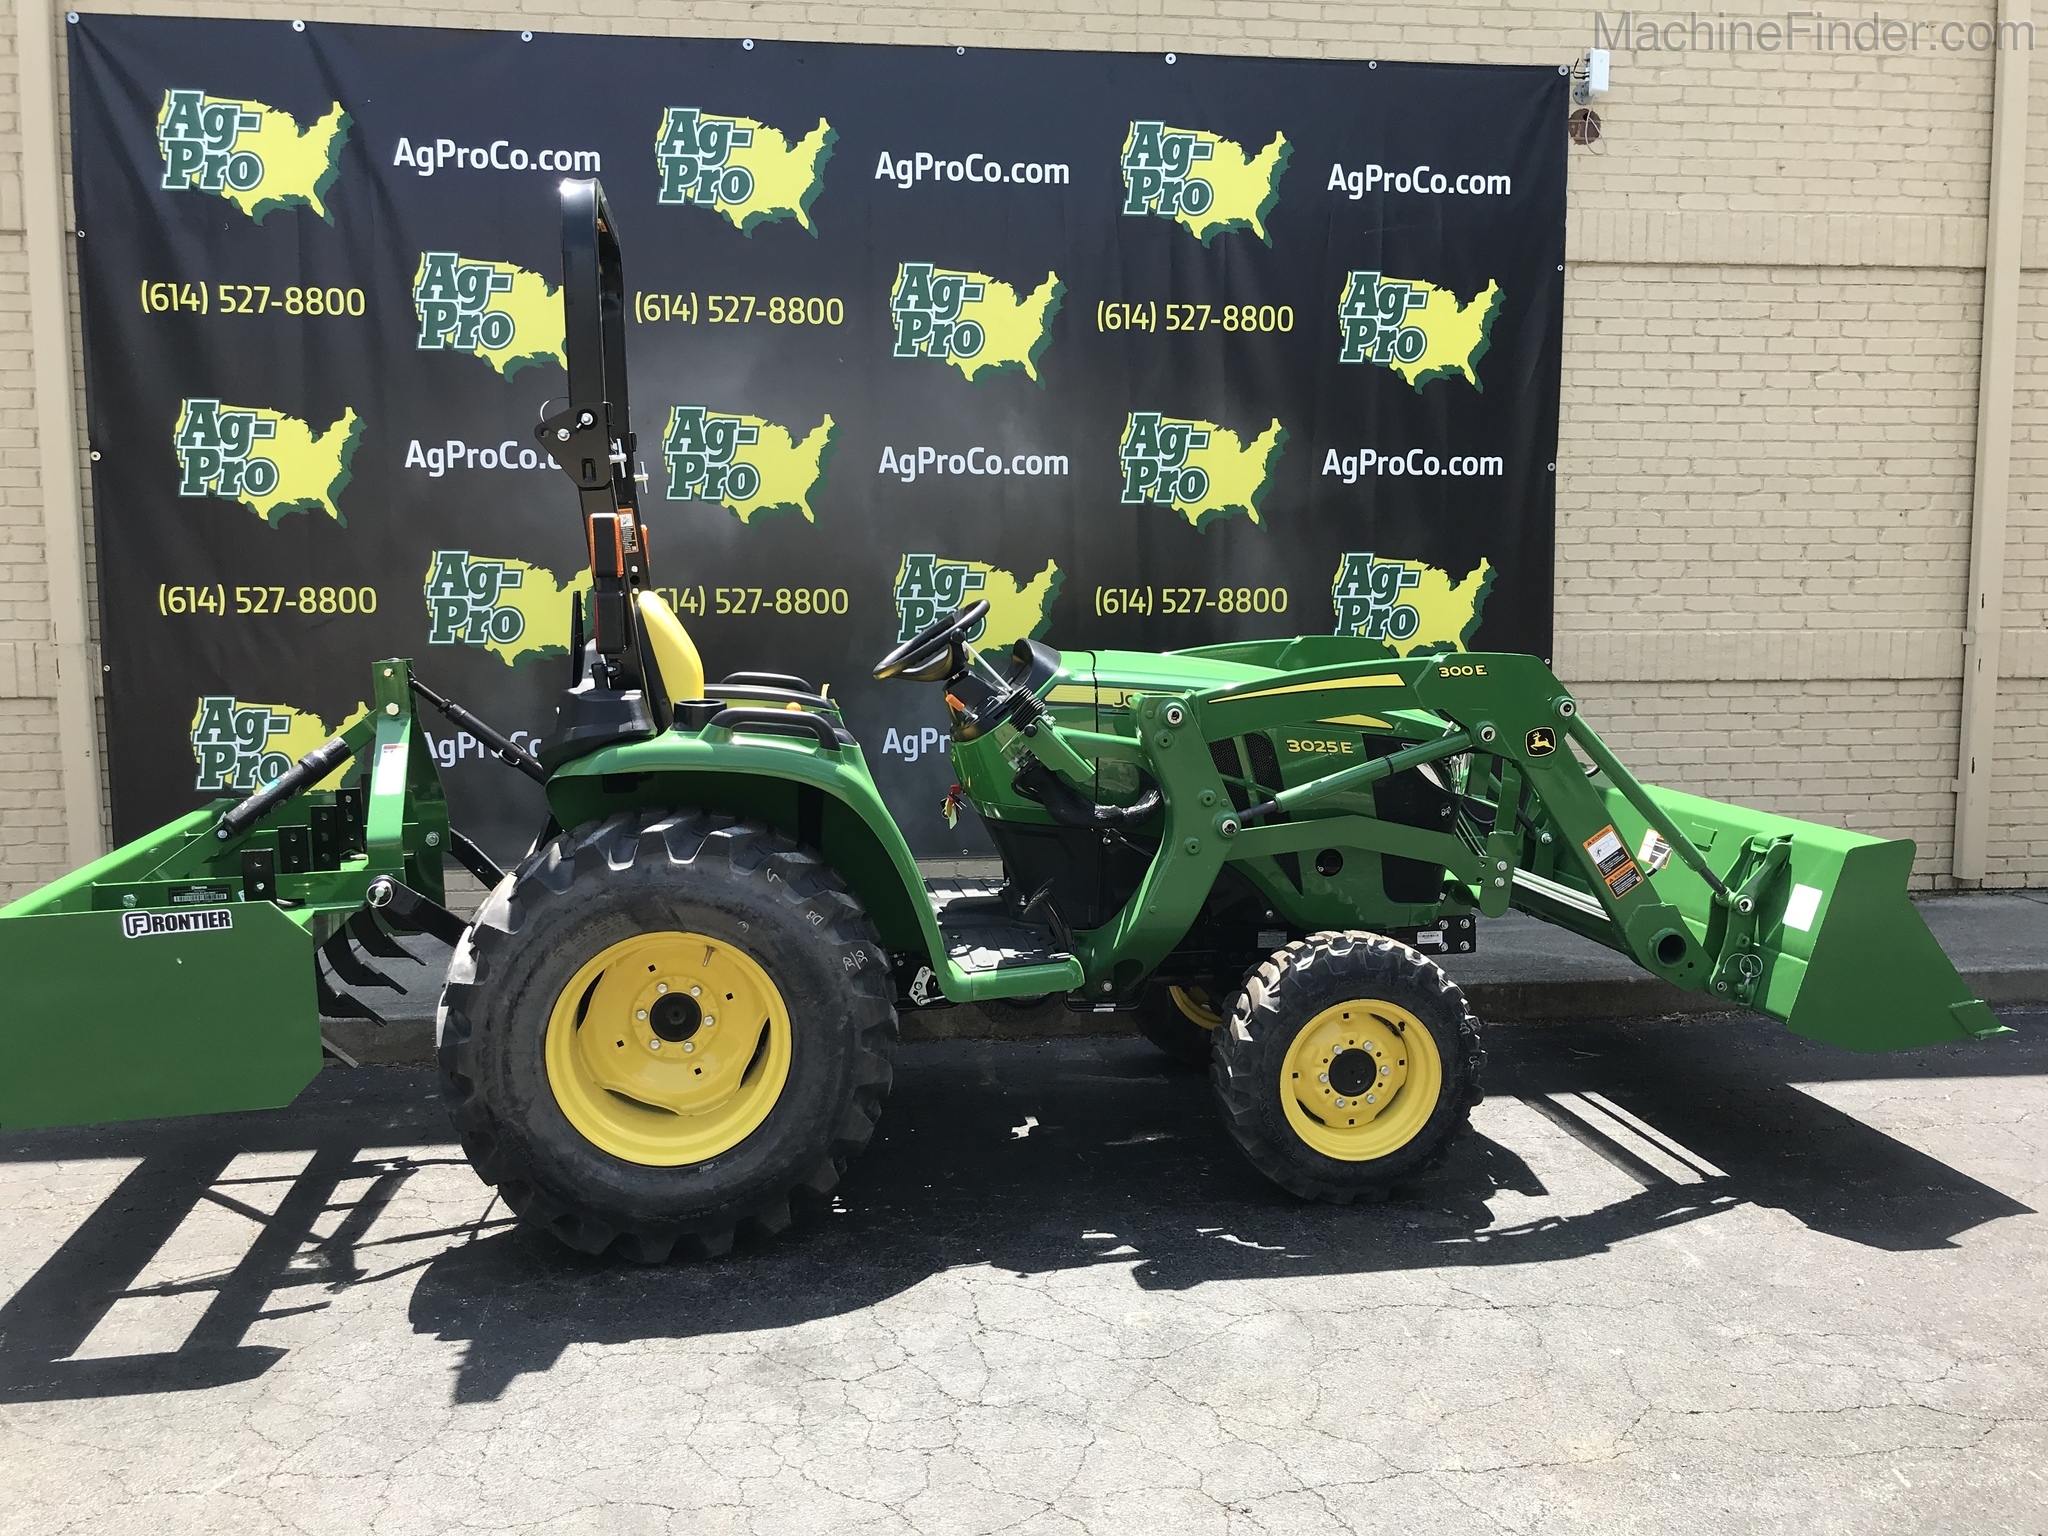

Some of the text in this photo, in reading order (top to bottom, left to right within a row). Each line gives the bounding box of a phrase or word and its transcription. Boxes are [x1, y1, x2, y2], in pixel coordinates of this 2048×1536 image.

[162, 140, 263, 190] Pro
[393, 138, 601, 176] AgProCo.com
[875, 152, 1070, 189] AgProCo.com
[660, 156, 754, 203] Pro
[1124, 168, 1213, 214] Pro
[1327, 164, 1511, 200] AgProCo.com
[141, 280, 366, 316] (614) 527-8800
[635, 291, 844, 325] (614) 527-8800
[1098, 301, 1294, 332] (614) 527-8800
[419, 300, 514, 349] Pro
[895, 310, 983, 357] Pro
[1341, 317, 1427, 362] Pro
[180, 447, 278, 495] Pro
[405, 440, 563, 477] AgProCo.c
[667, 453, 759, 500] Pro
[879, 446, 1069, 483] AgProCo.com
[1322, 449, 1503, 484] AgProCo.com
[1123, 458, 1208, 503] Pro
[160, 584, 377, 616] (614) 527-8800
[715, 588, 849, 614] 527-8800
[1096, 586, 1288, 616] (614) 527-8800
[1336, 598, 1419, 639] Pro
[431, 597, 523, 643] Pro
[124, 910, 231, 937] FRONTIER
